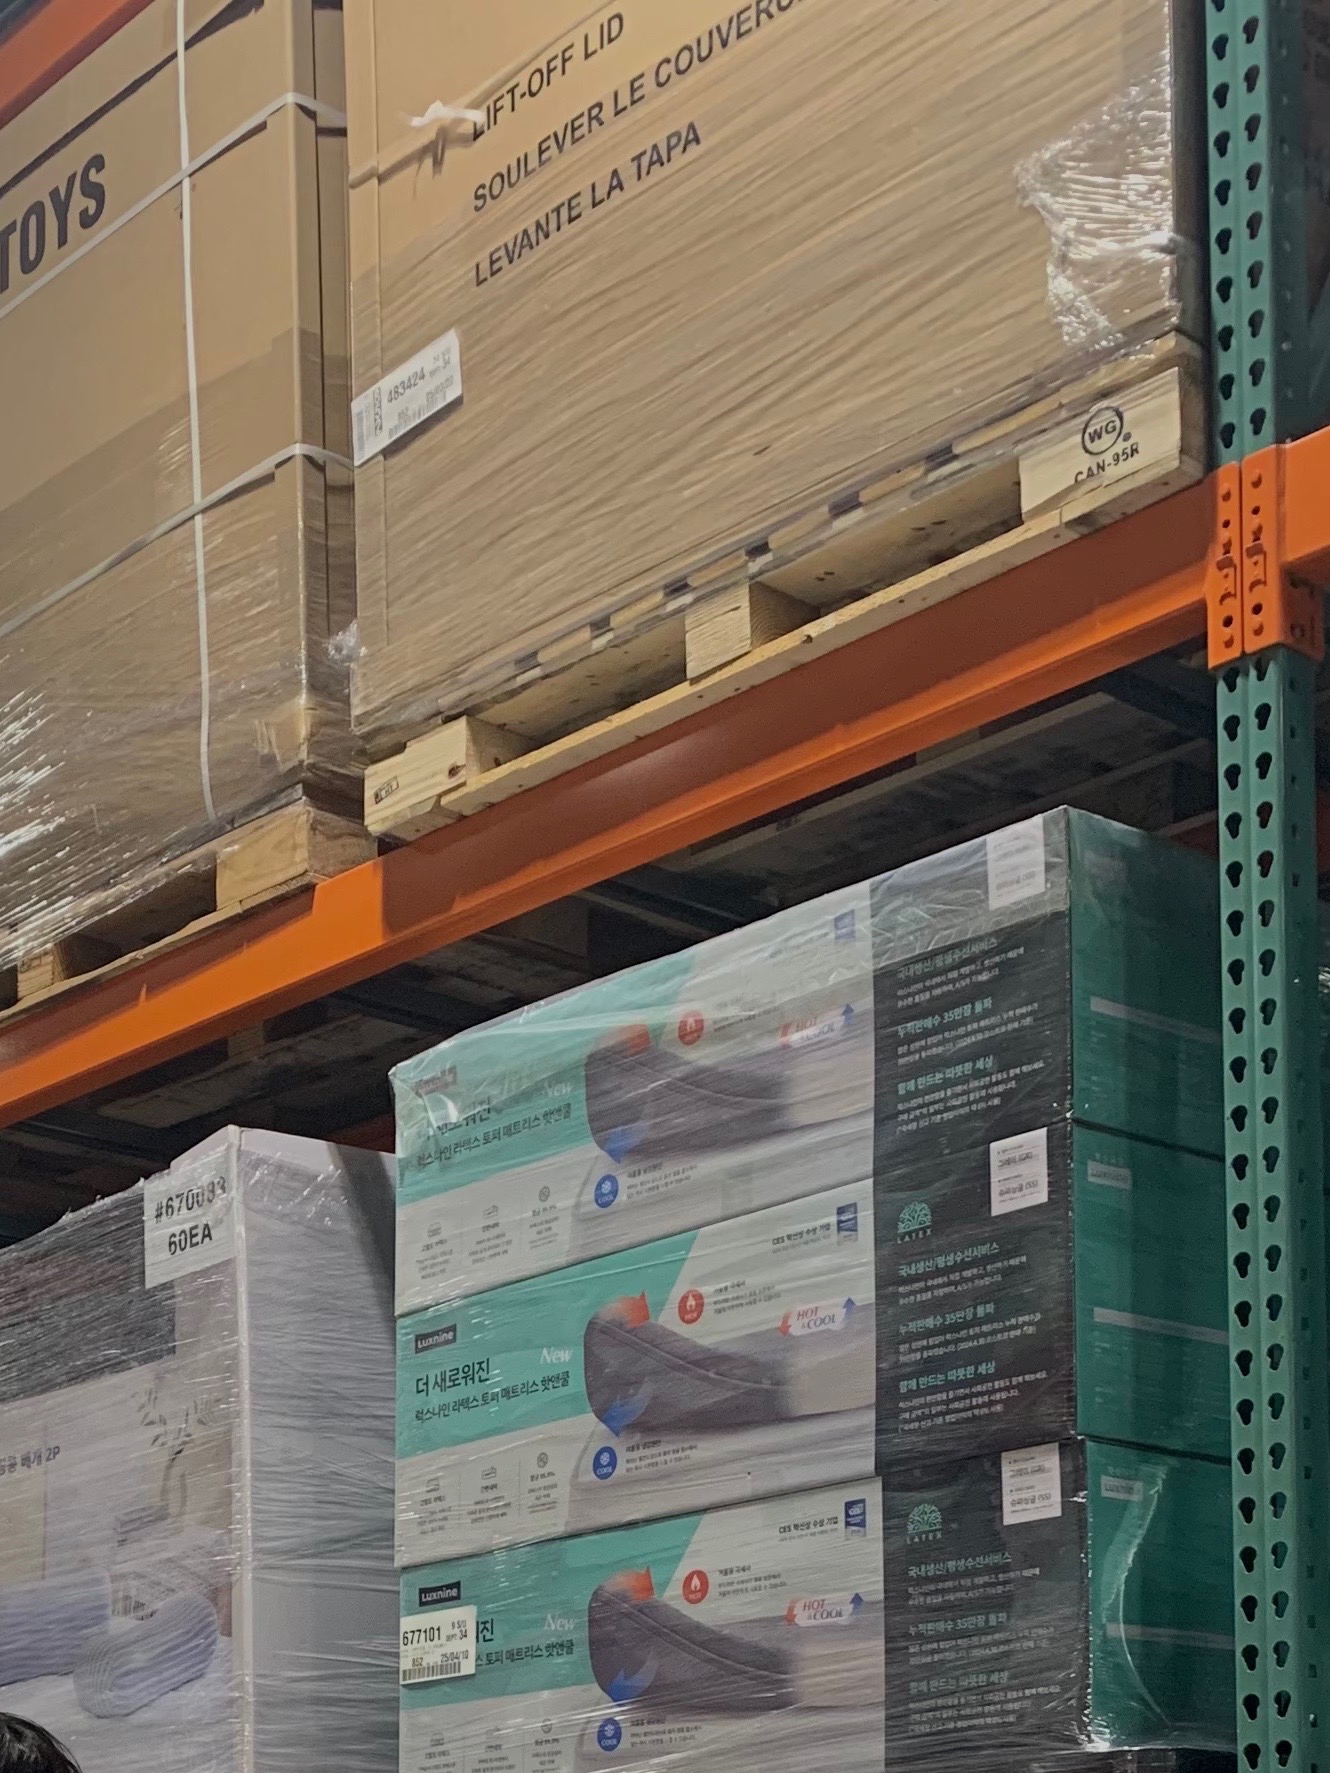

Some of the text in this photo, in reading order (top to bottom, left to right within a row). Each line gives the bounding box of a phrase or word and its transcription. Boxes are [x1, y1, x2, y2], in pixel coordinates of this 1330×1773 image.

[472, 12, 624, 141] LIFT-OFF LID
[473, 101, 605, 213] SOULEVER
[612, 72, 646, 118] LE
[474, 120, 702, 288] LEVANTE LA TAPA
[387, 366, 425, 404] 483424
[1087, 419, 1117, 444] WG
[1074, 442, 1140, 484] CAN-95R
[974, 1054, 994, 1070] 세상
[502, 1113, 541, 1137] 매트리스
[168, 1222, 213, 1256] 60EA
[897, 1228, 932, 1244] LATEX
[796, 1306, 819, 1321] HOT
[944, 1306, 974, 1325] 35만장
[416, 1329, 454, 1350] Luxnine
[539, 1347, 573, 1365] New
[415, 1357, 491, 1397] 더 새로워진
[918, 1372, 947, 1388] 만드는
[947, 1365, 975, 1382] 따뜻한
[976, 1359, 996, 1375] 세상
[415, 1404, 451, 1424] 럭스나인
[451, 1395, 480, 1414] 라텍스
[500, 1379, 539, 1400] 매트리스
[541, 1370, 570, 1393] 핫앤쿨
[45, 1445, 61, 1462] 2P
[906, 1533, 942, 1545] LATEX
[421, 1587, 458, 1602] Luxnine
[802, 1599, 826, 1612] HOT
[543, 1612, 576, 1631] New
[402, 1626, 441, 1646] 677101
[459, 1628, 468, 1640] 34
[505, 1644, 544, 1663] 매트리스
